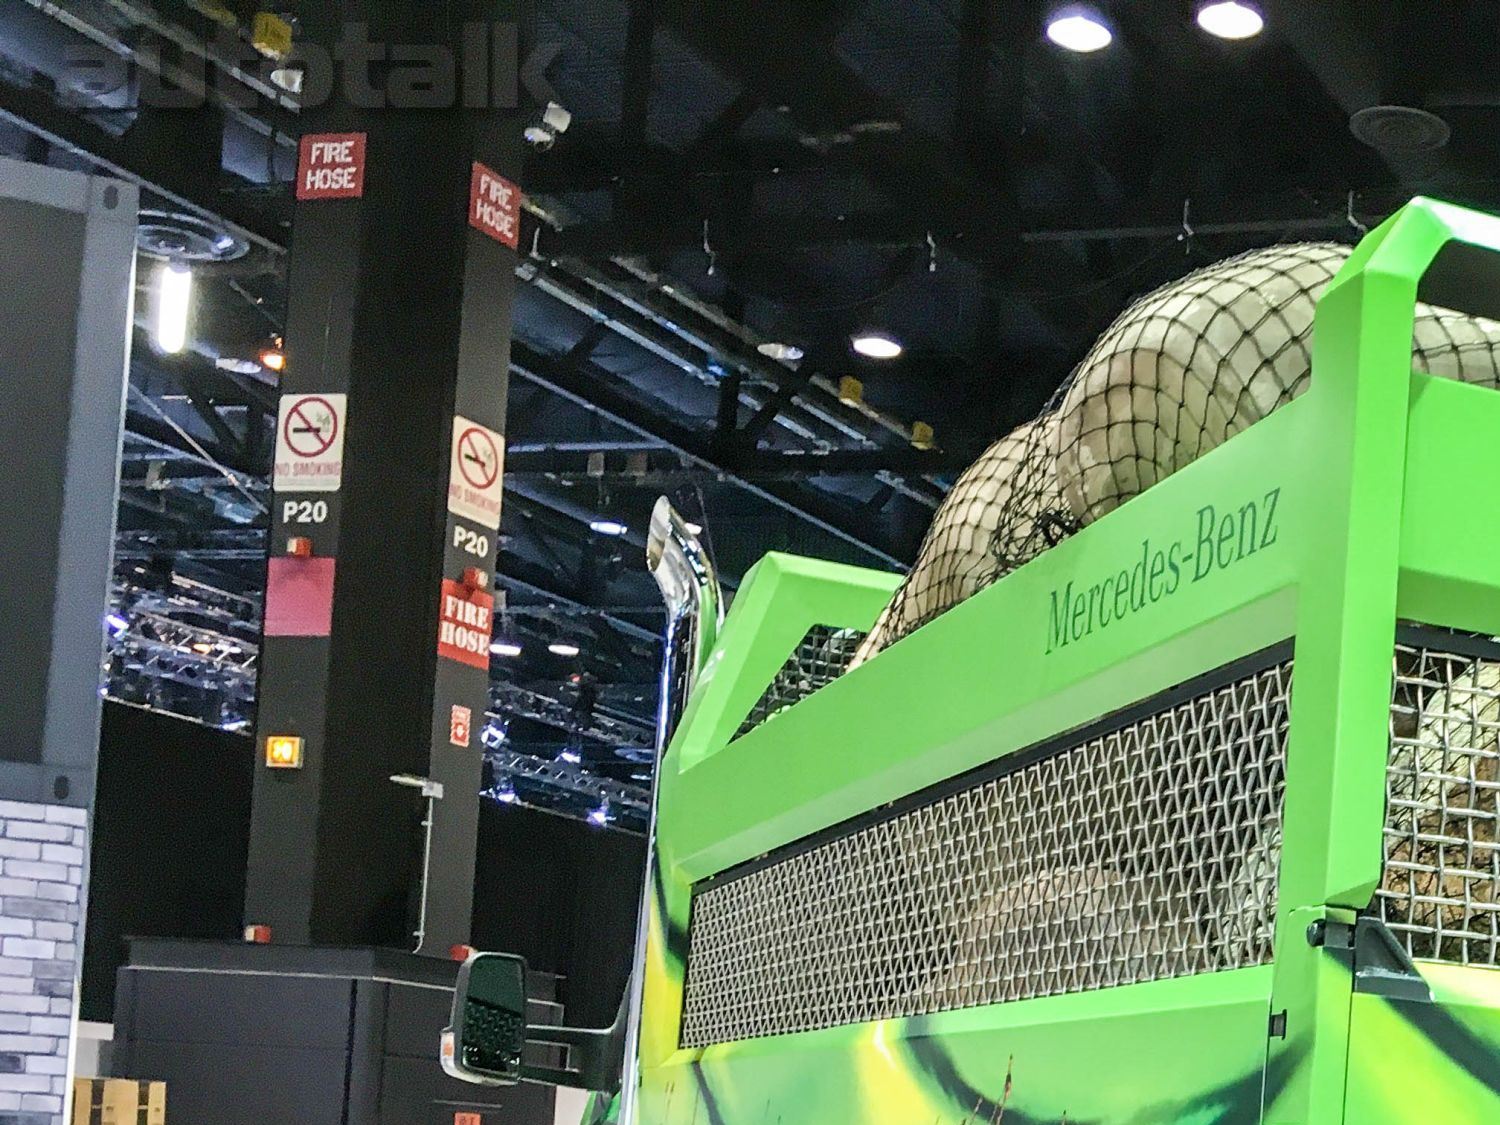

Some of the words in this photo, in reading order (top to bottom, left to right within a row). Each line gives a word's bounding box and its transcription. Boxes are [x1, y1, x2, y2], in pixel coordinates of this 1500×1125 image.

[310, 140, 355, 165] FIRE
[305, 166, 357, 190] HOSE
[479, 174, 513, 210] FIRE
[476, 199, 514, 239] HOSE
[275, 462, 290, 477] NO
[293, 462, 341, 477] SMOKING
[283, 500, 328, 524] P20
[453, 526, 489, 558] P20
[1045, 487, 1281, 655] Mercedes-Benz
[444, 594, 489, 630] FIRE
[440, 620, 490, 656] HOSE
